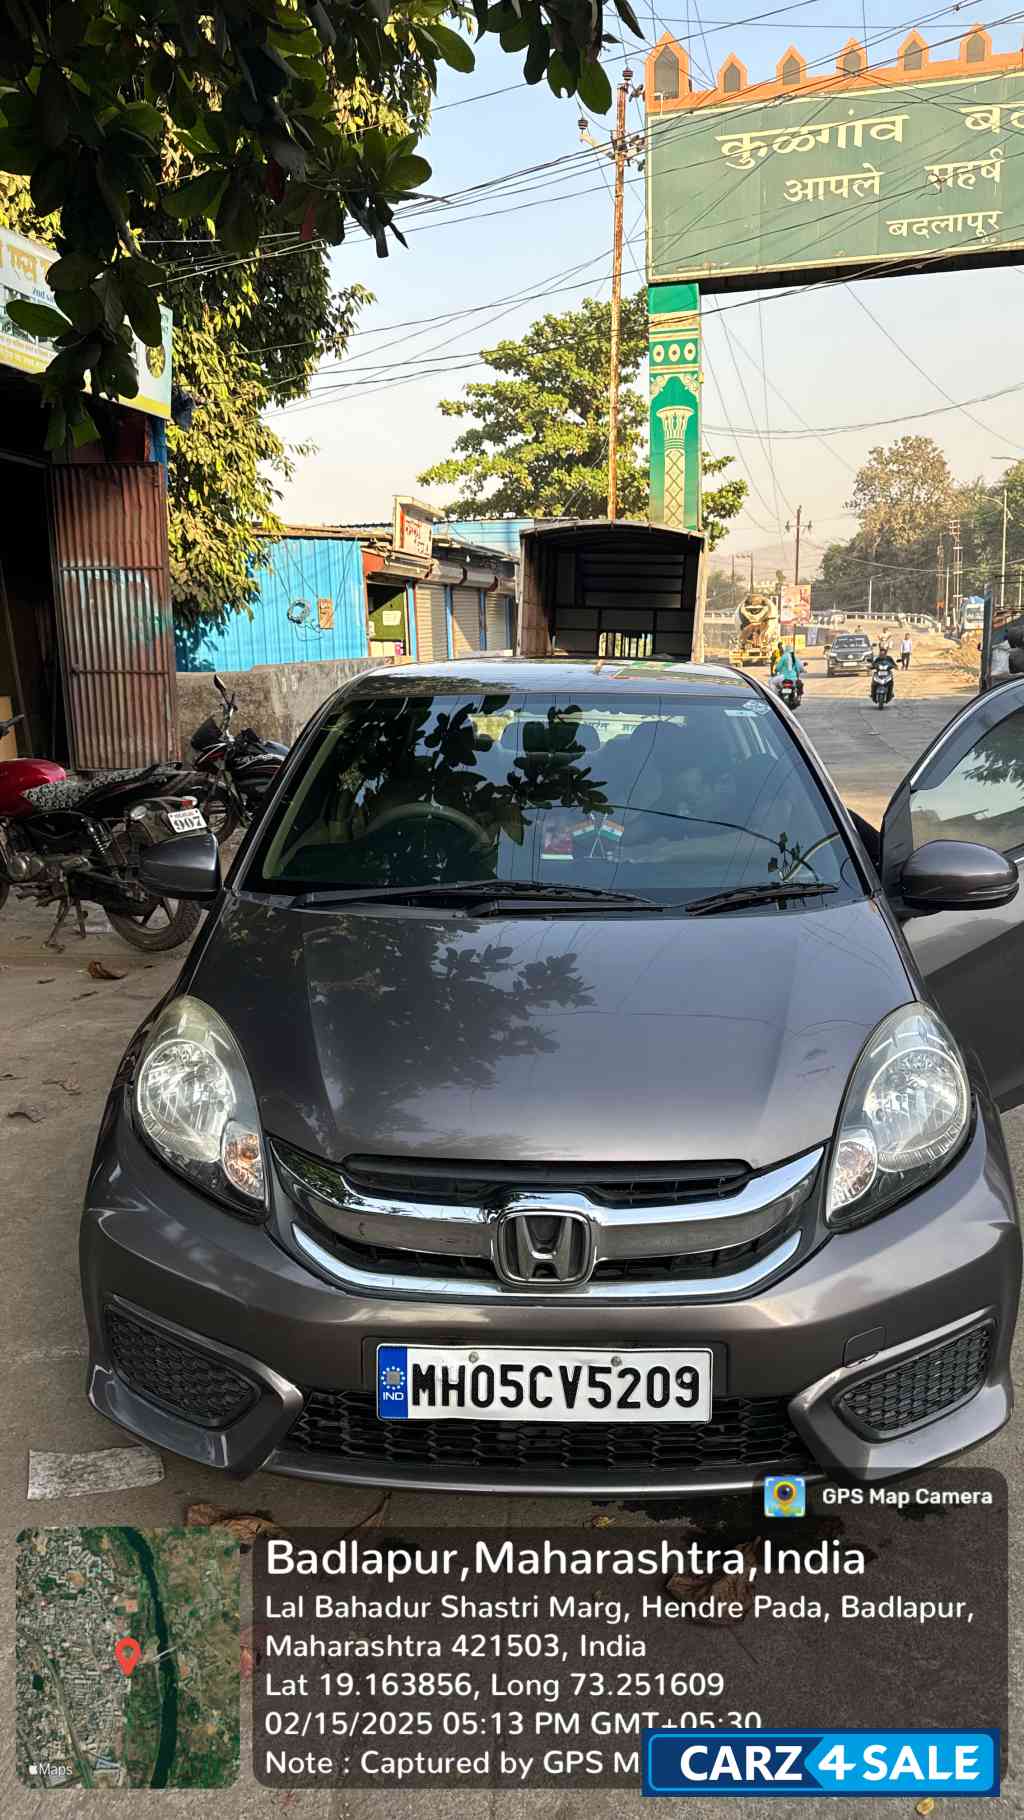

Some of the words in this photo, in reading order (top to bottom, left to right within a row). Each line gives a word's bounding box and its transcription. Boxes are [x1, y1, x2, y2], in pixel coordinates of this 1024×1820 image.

[714, 109, 910, 169] कुळगांव
[784, 162, 885, 201] आपले
[886, 211, 1003, 239] बदलापूर
[382, 1391, 405, 1401] IND
[411, 1363, 700, 1410] MH05CV5209
